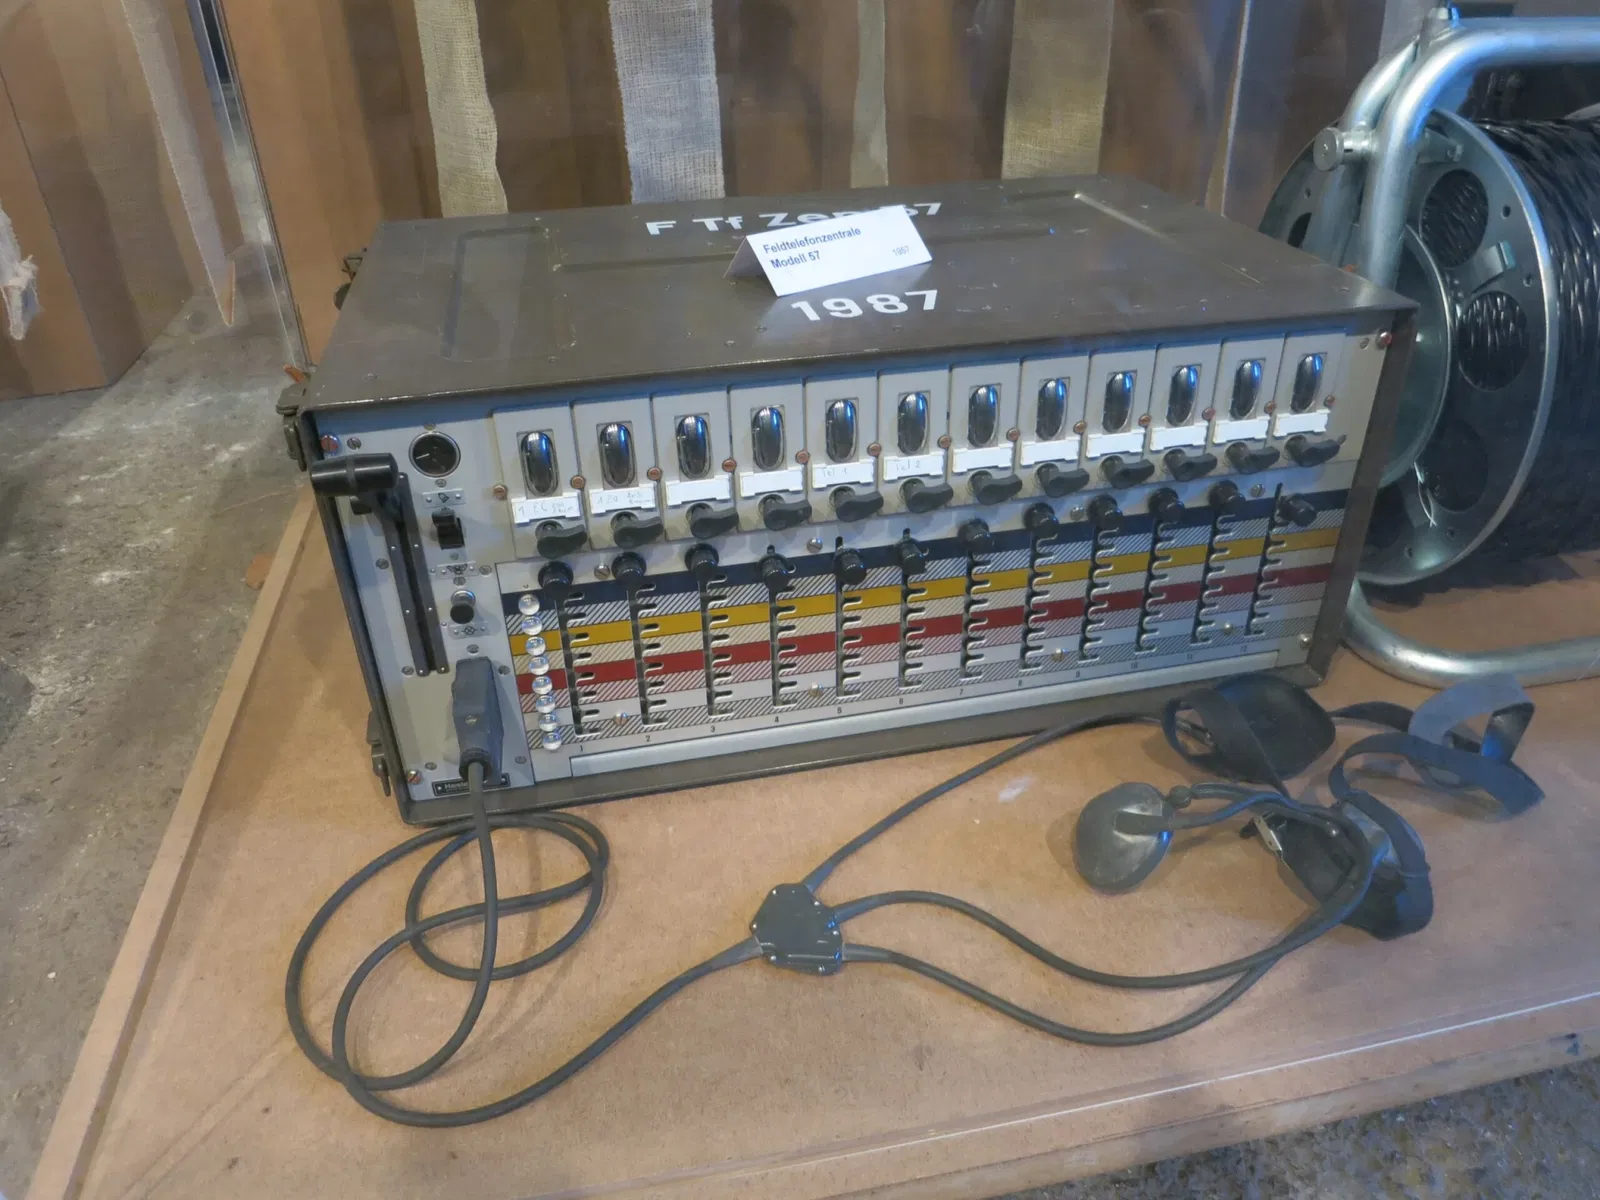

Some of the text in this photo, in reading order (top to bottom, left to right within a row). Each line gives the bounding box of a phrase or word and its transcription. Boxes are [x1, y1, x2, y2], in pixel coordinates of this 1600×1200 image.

[646, 220, 677, 236] F
[693, 215, 743, 233] Tf
[758, 209, 867, 228] Zen
[763, 227, 862, 254] Feldtelefonzentrale
[770, 250, 821, 269] Modell 57
[791, 289, 939, 322] 1987
